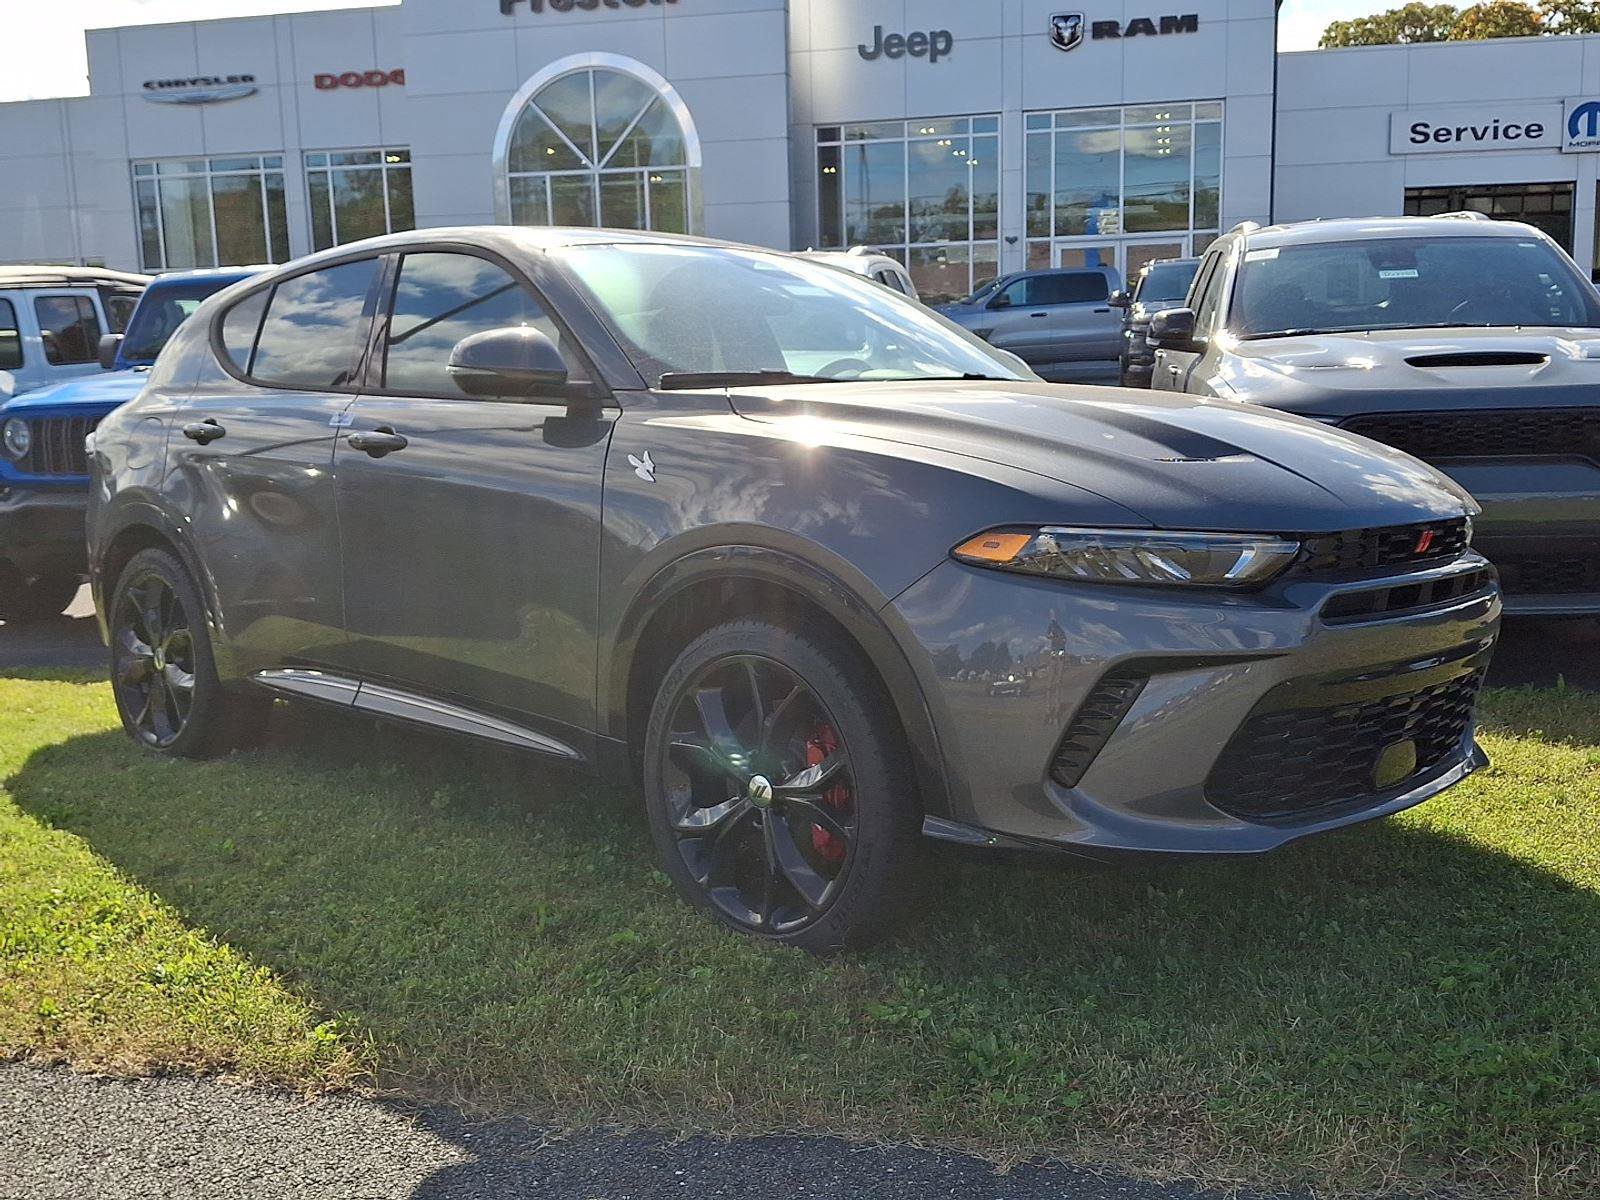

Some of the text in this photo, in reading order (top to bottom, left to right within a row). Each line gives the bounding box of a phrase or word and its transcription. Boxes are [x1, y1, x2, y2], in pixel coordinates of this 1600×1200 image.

[1092, 14, 1198, 40] RAM
[857, 26, 953, 63] Jeep
[143, 75, 255, 90] CHRYSLER
[1409, 119, 1544, 144] Service
